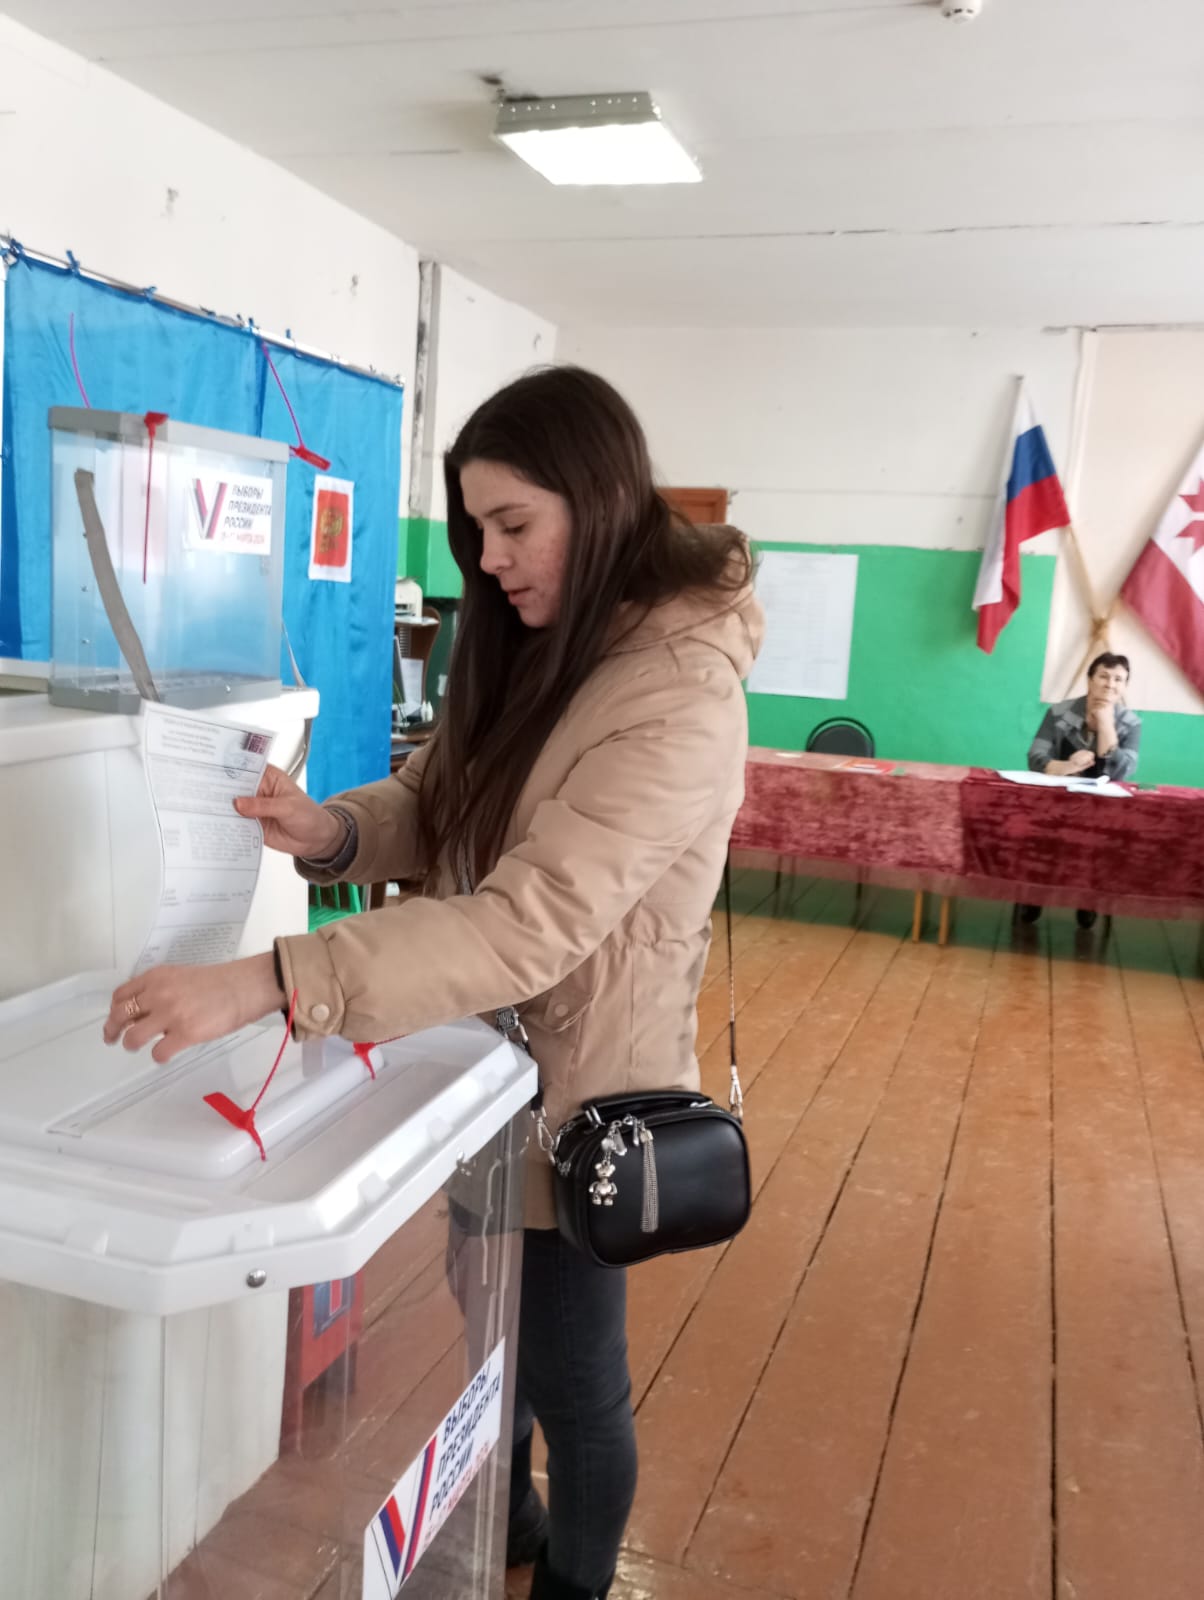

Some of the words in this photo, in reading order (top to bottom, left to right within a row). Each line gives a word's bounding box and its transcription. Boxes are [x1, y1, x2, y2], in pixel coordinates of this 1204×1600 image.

[224, 516, 254, 530] РОССИИ
[228, 500, 272, 516] ПРЕЗИДЕНТА
[436, 1370, 501, 1483] ПРЕЗИДЕНТА
[443, 1360, 491, 1445] ВЫБОРЫ
[429, 1437, 474, 1521] РОССИИ
